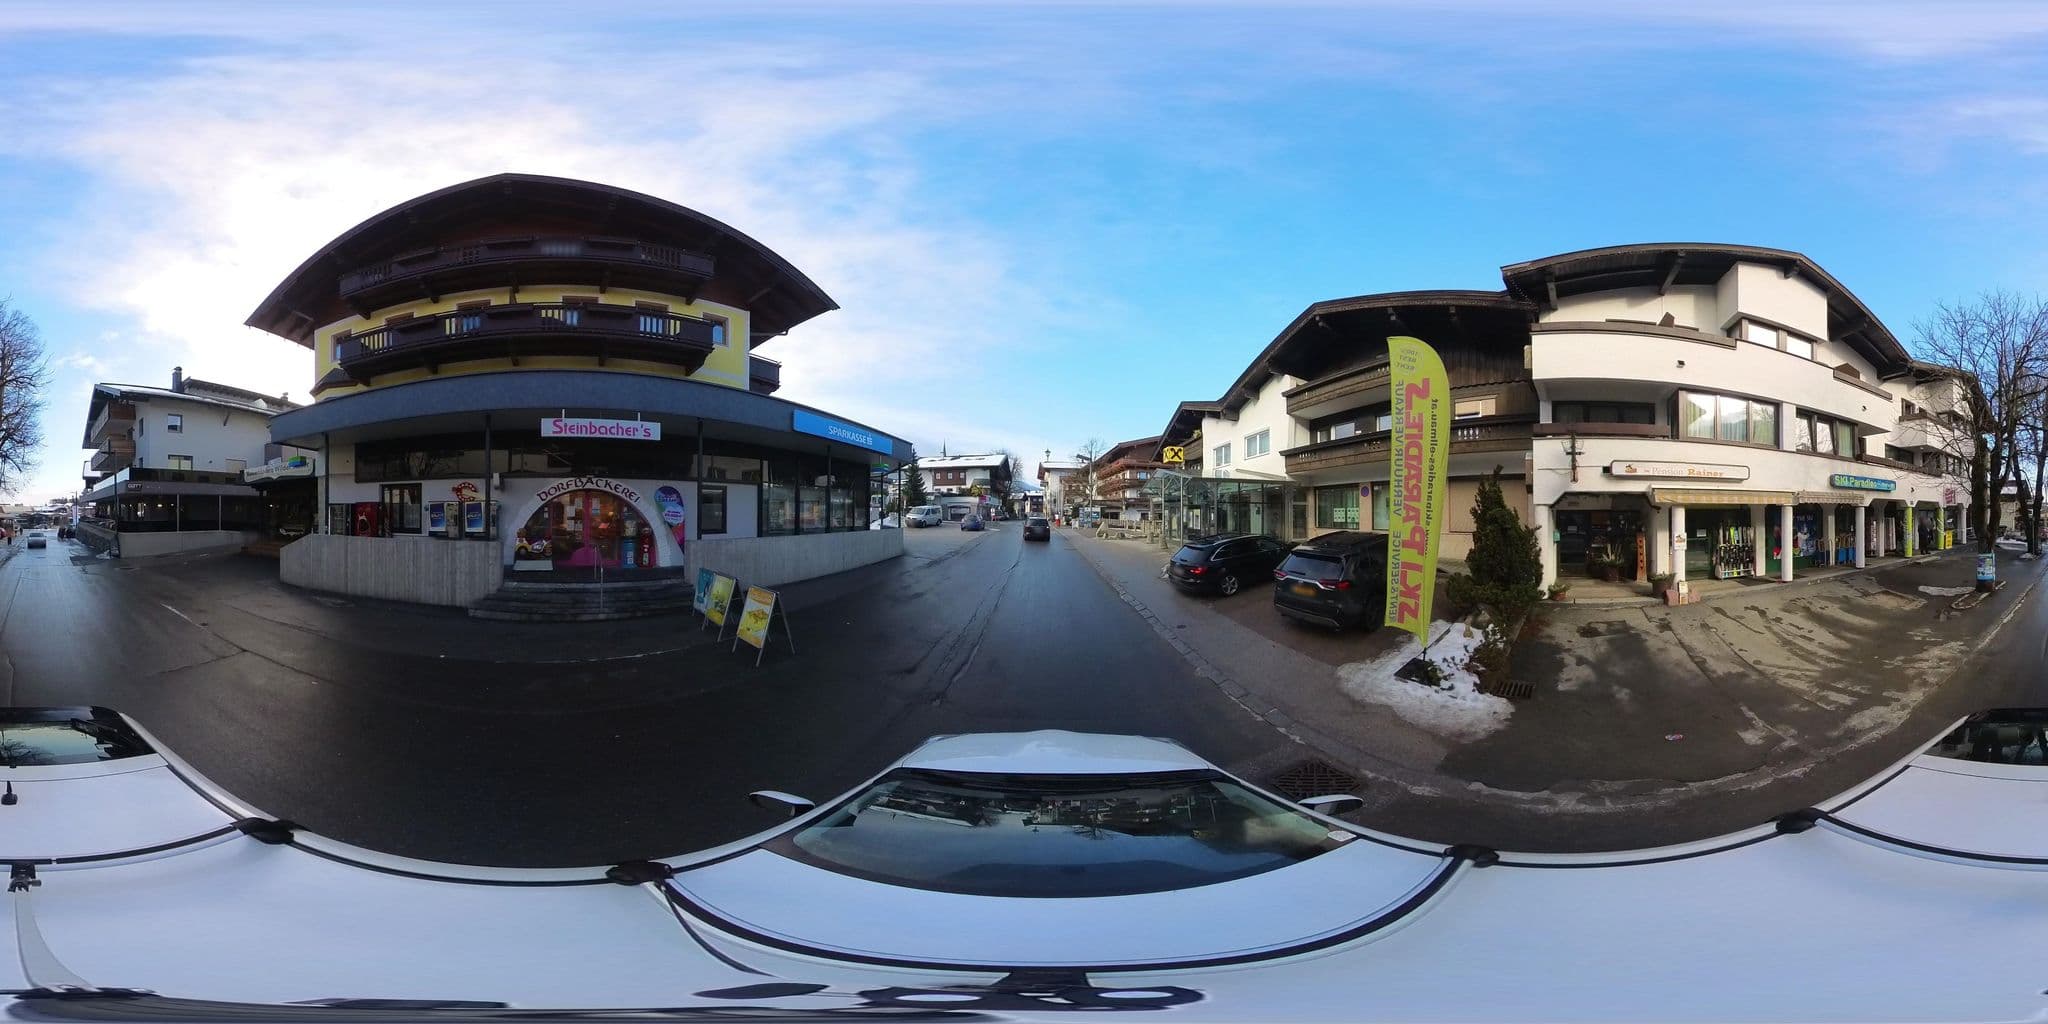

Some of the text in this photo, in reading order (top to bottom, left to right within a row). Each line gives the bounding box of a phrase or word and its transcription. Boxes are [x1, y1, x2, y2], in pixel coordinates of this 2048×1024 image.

[551, 418, 652, 438] Steinbacher's
[828, 425, 867, 444] SPARKASSE
[1687, 467, 1724, 478] Rainer
